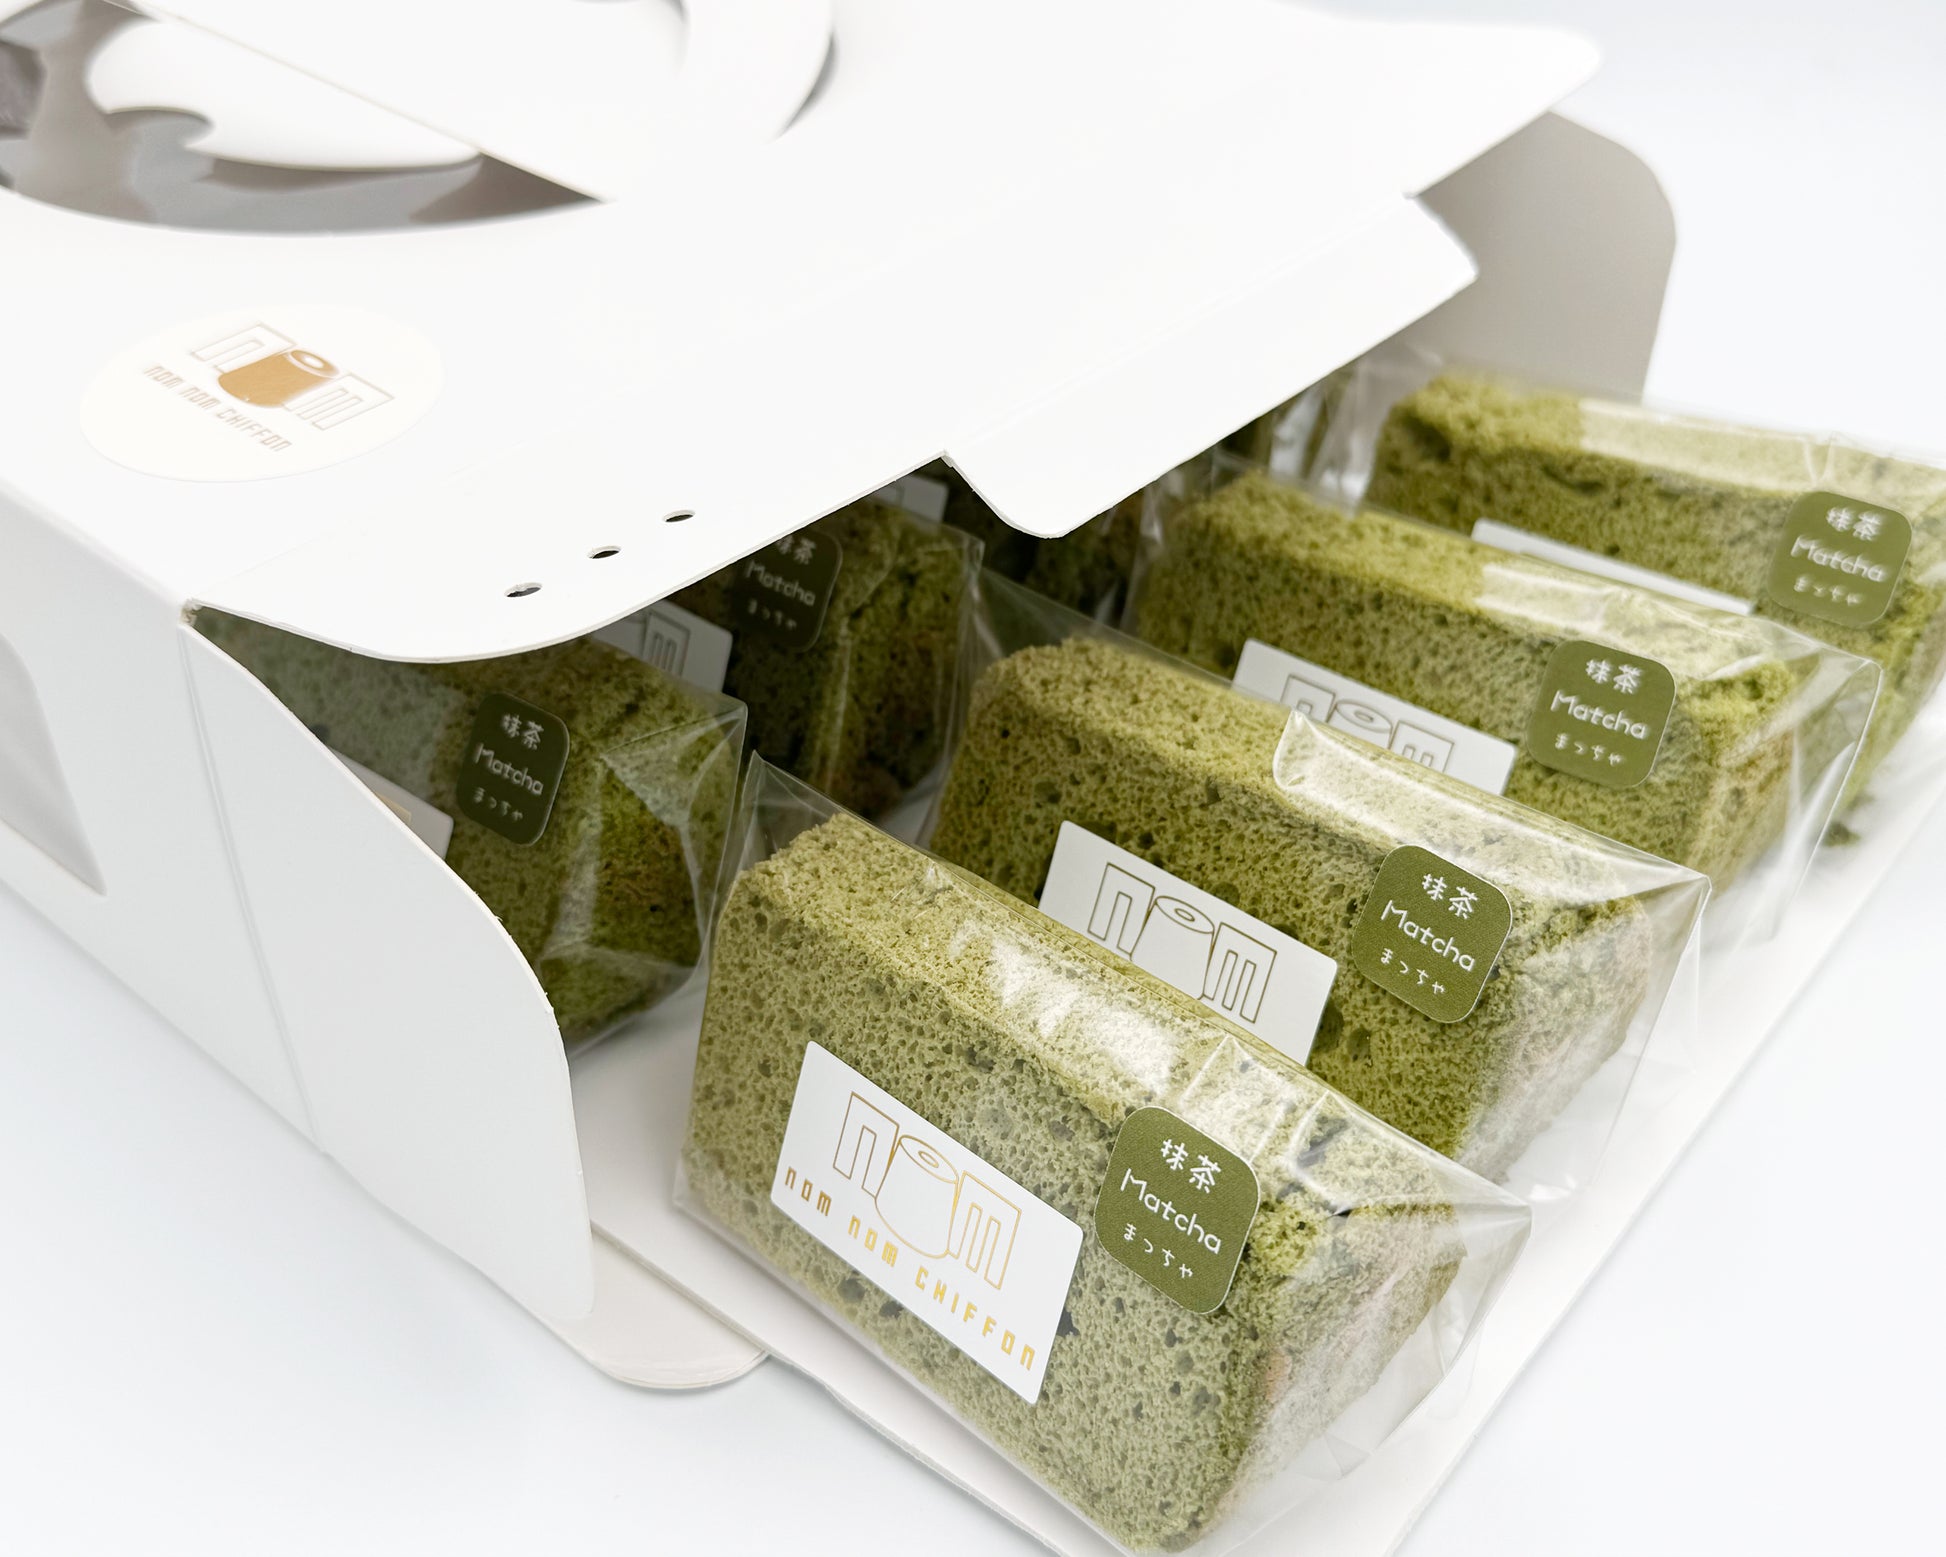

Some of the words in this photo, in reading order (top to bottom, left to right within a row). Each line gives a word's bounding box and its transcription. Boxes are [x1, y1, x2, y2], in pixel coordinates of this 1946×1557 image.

[1826, 507, 1883, 541] 抹茶
[1790, 534, 1887, 582] Matcha
[746, 560, 816, 606] Matcha
[1585, 659, 1642, 694] 抹茶
[502, 713, 544, 750] 抹茶
[1550, 690, 1649, 740] Matcha
[474, 743, 544, 795] Matcha
[1421, 873, 1478, 919] 抹茶
[1380, 900, 1475, 971] Matcha
[1161, 1138, 1222, 1194] 抹茶
[1120, 1168, 1222, 1254] Matcha
